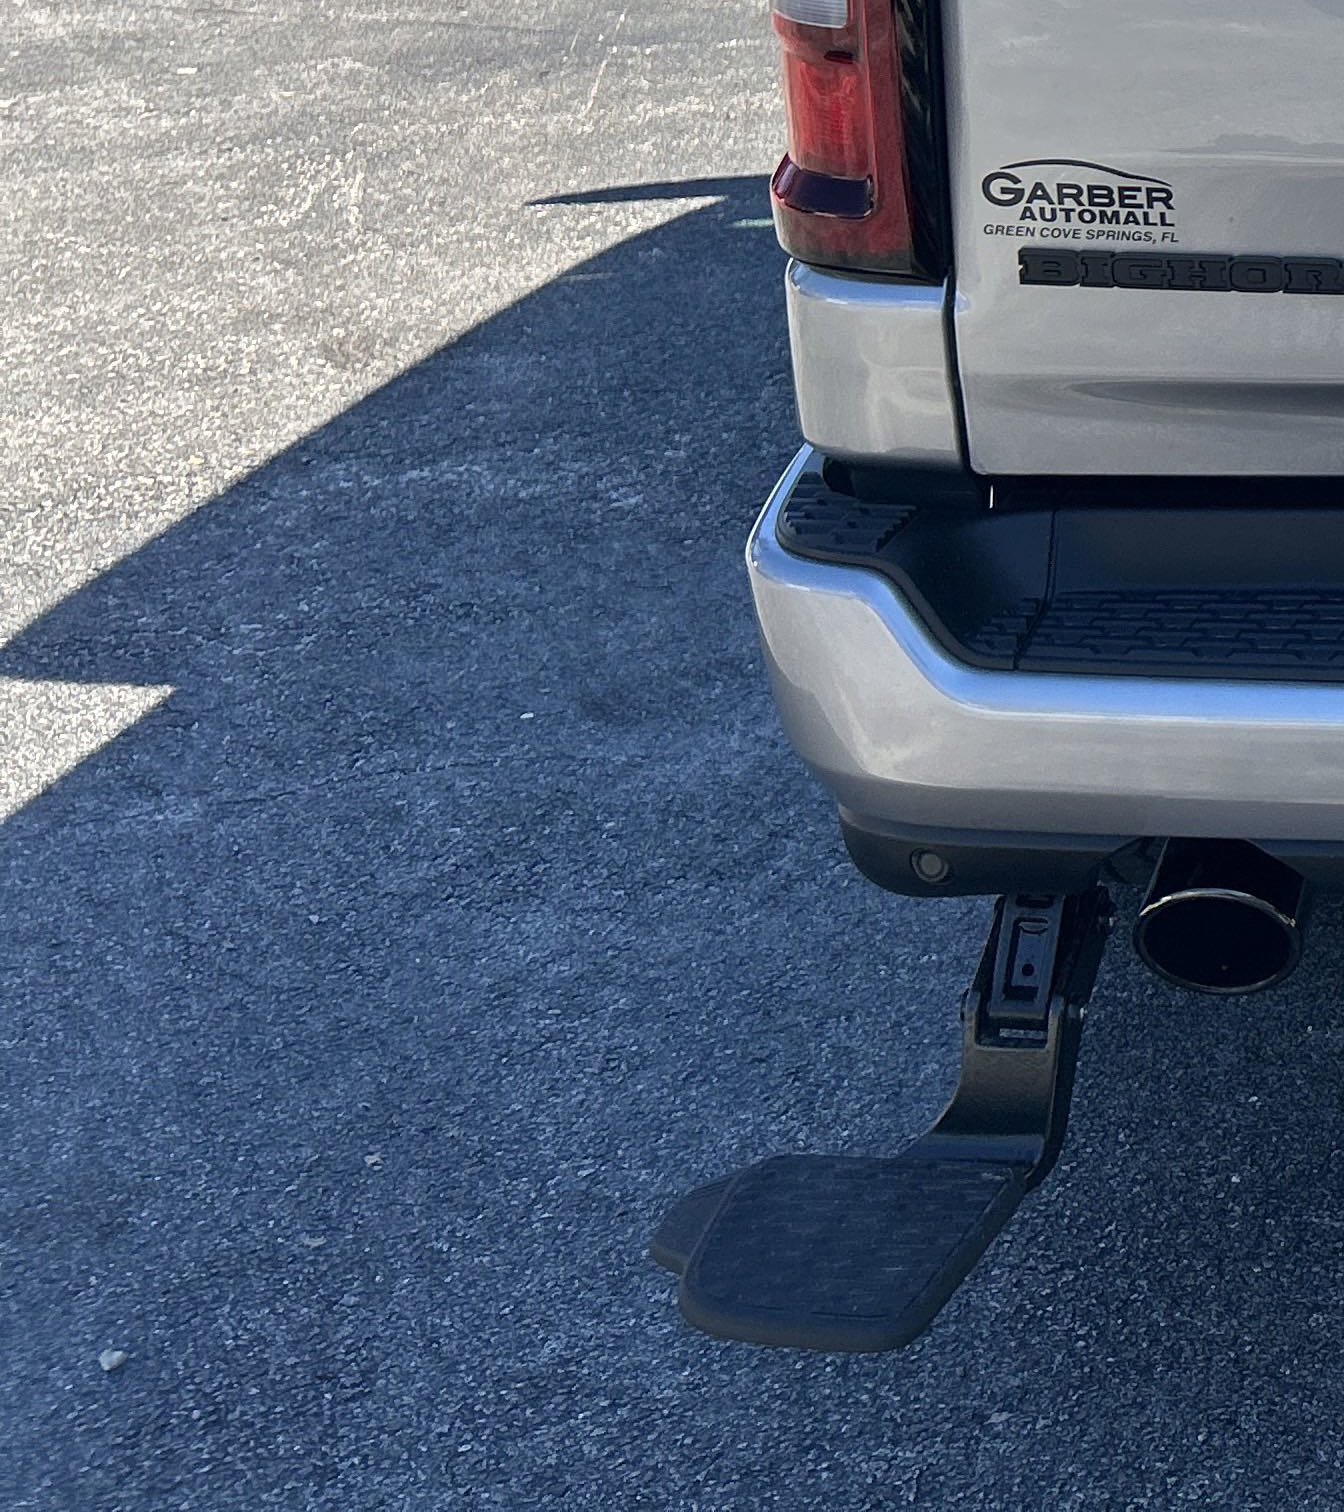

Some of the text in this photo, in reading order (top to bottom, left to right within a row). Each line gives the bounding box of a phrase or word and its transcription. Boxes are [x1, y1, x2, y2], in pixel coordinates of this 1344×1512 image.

[981, 170, 1176, 210] GARBER
[1019, 206, 1175, 227] AUTOMALL
[983, 224, 1179, 245] GREEN COVE SPRINGS, FL
